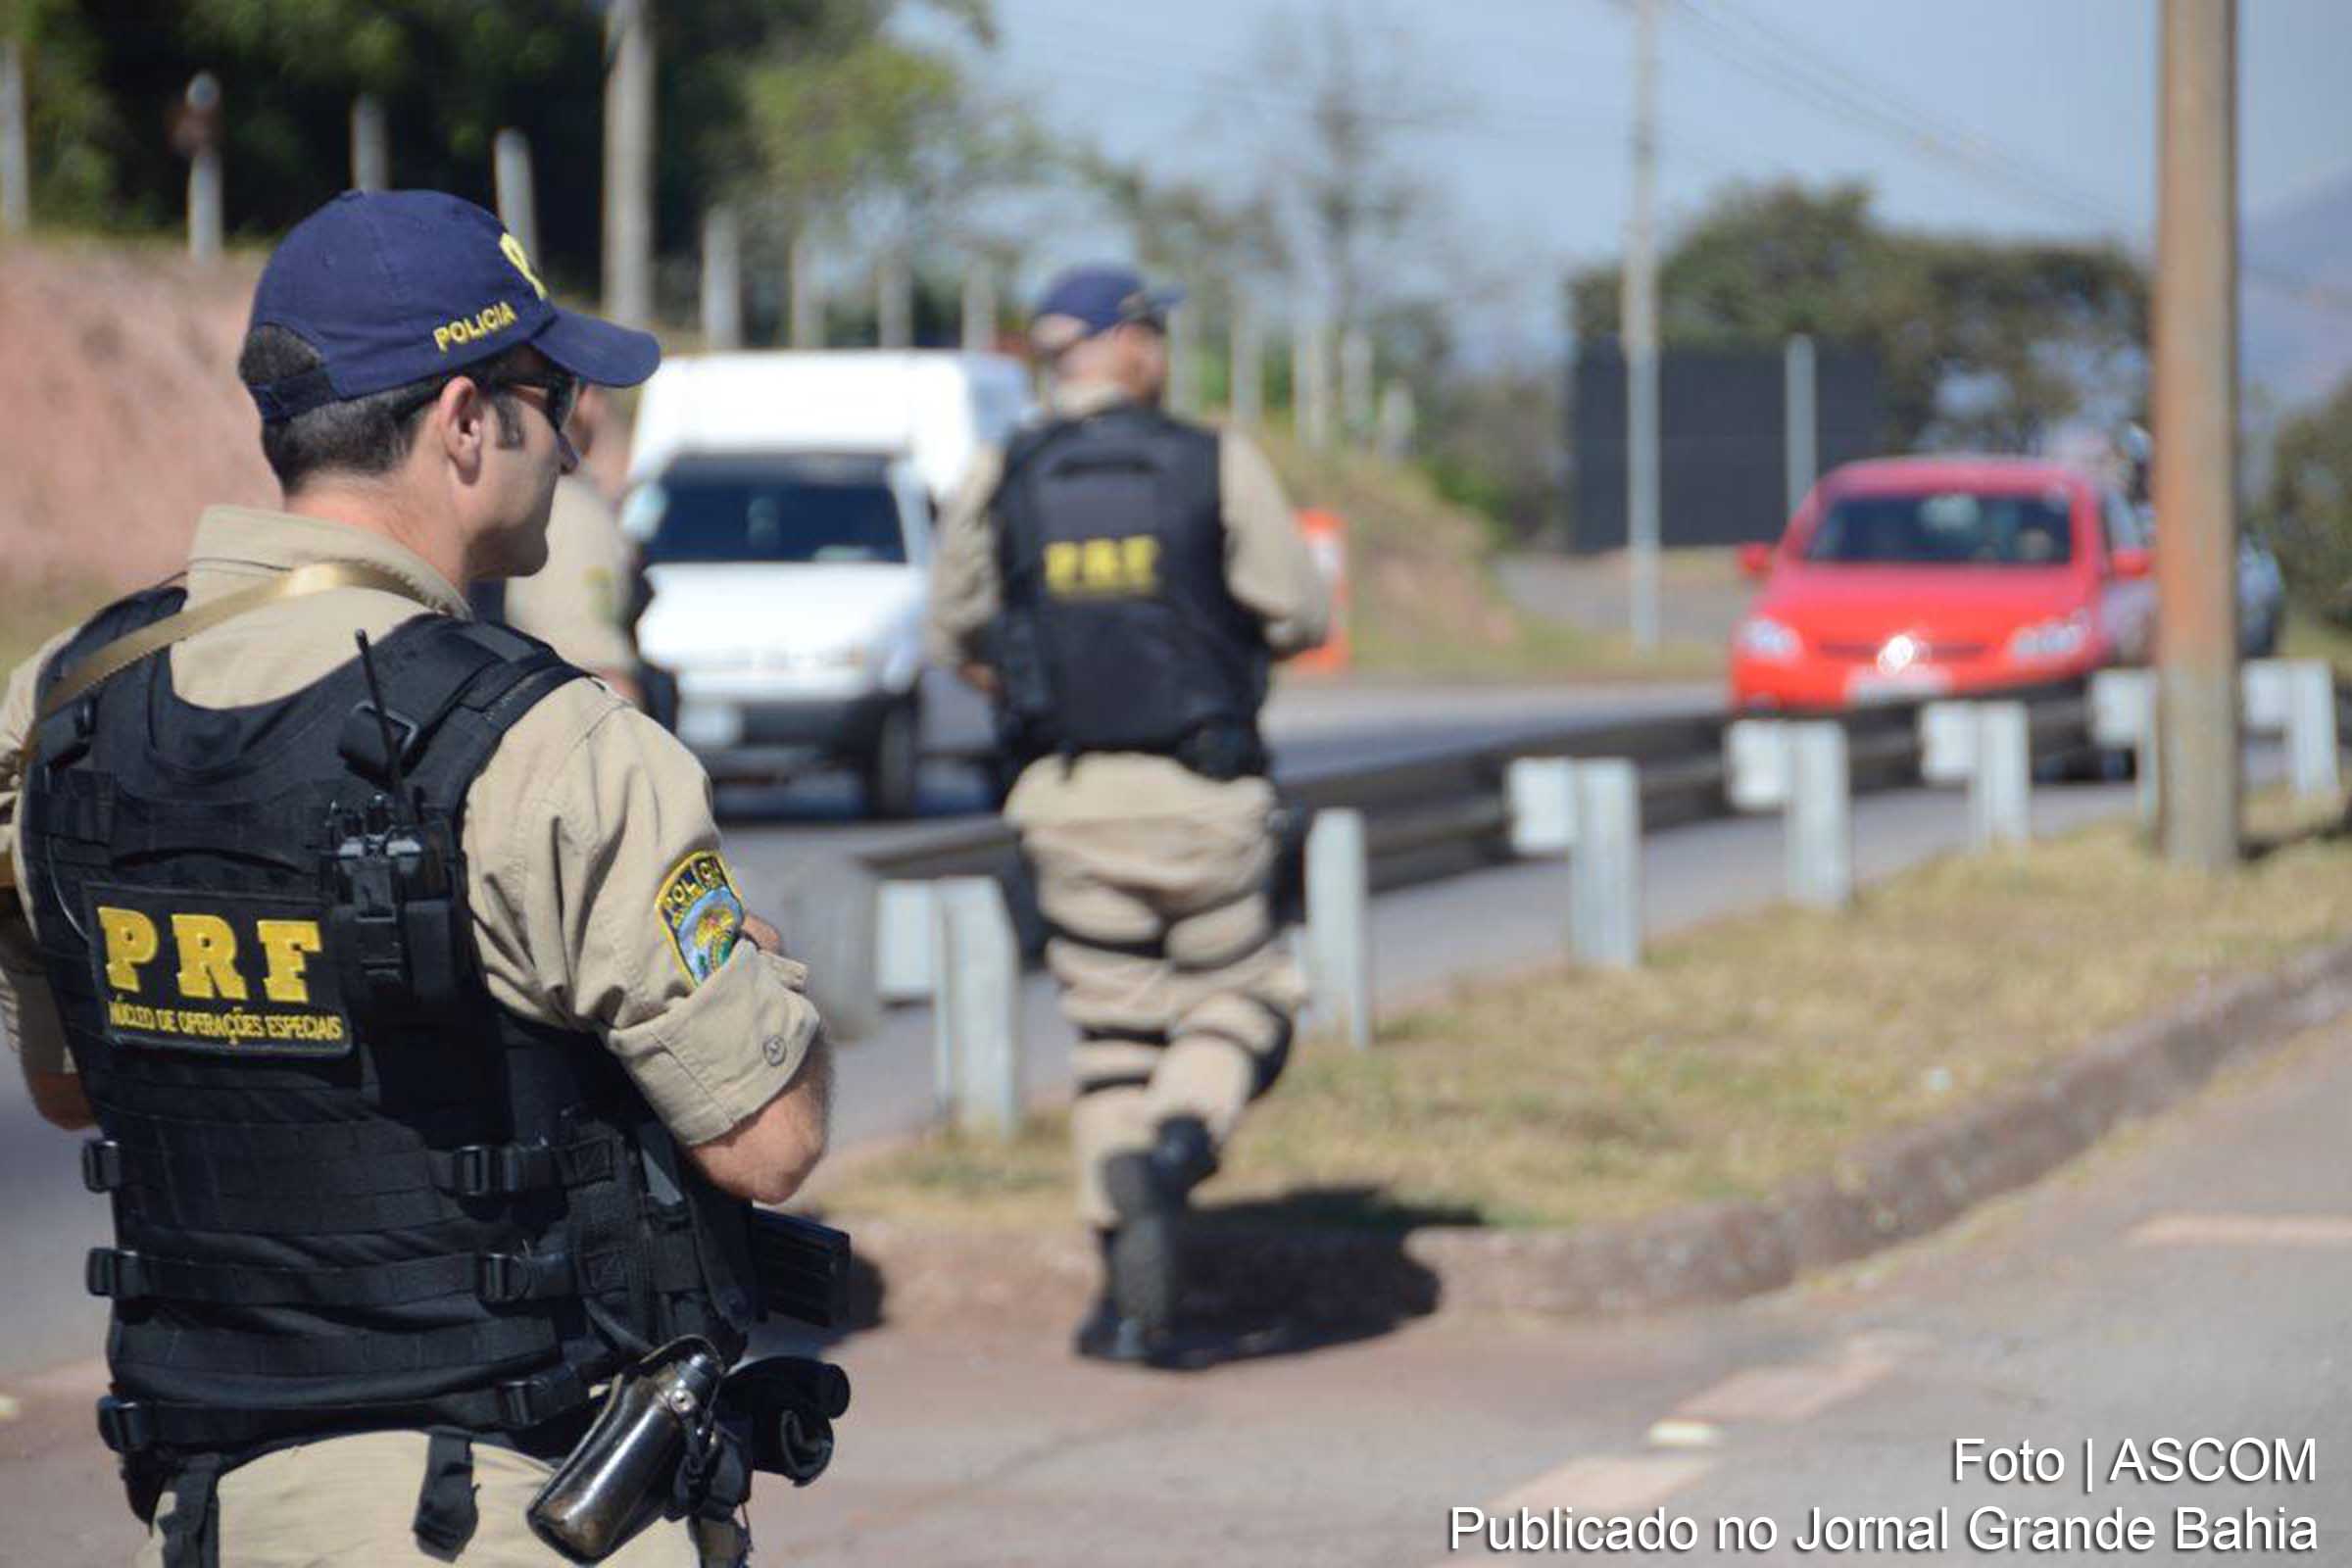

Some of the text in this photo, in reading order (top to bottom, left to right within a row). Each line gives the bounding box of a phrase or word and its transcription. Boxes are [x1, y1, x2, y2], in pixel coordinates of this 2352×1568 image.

[433, 301, 517, 353] POLICIA
[1043, 534, 1162, 596] PRF
[98, 906, 321, 1004] PRF
[156, 1008, 177, 1033] DE
[265, 1015, 343, 1041] ESPECIAIS
